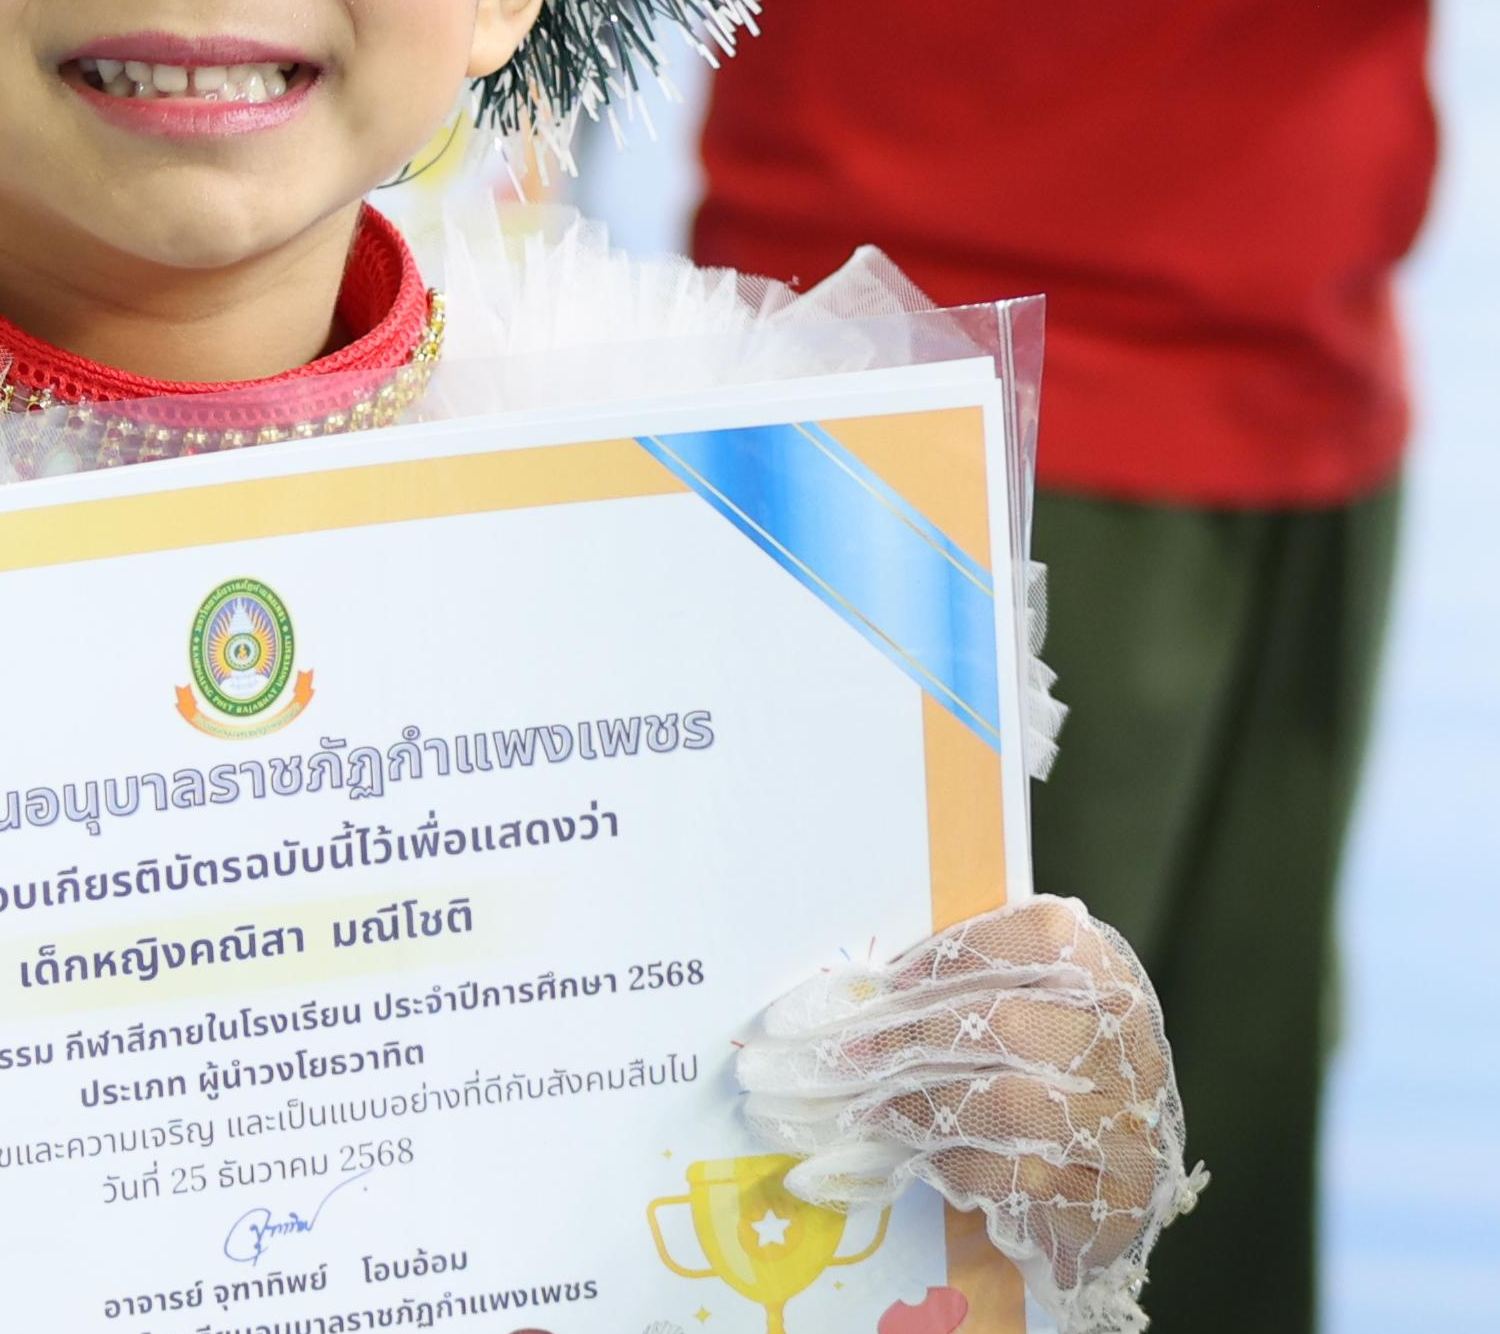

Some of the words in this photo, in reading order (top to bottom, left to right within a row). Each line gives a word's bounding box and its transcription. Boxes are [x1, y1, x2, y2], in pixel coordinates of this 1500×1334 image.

[19, 923, 305, 988] เด็กหญิงคณิสา
[332, 897, 474, 950] มณีโชติ
[65, 998, 362, 1061] กีฬาสีภายในโรงเรียน
[373, 969, 617, 1023] ประจำปีการศึกษา
[628, 959, 705, 993] 2568
[80, 1072, 187, 1109] ประเภท
[199, 1040, 425, 1101] ผู้นำวงโยธวาทิต
[227, 1054, 699, 1140] และเป็นแบบอย่างที่ดีกับสังคมสืบไป
[102, 1160, 161, 1204] วันที่
[171, 1165, 207, 1195] 25
[218, 1152, 330, 1189] ธันวาคม
[339, 1137, 415, 1174] 2568
[104, 1280, 203, 1320] อาจารย์
[214, 1263, 329, 1312] จุฑาทิพย์
[361, 1248, 469, 1285] โอบอ้อม
